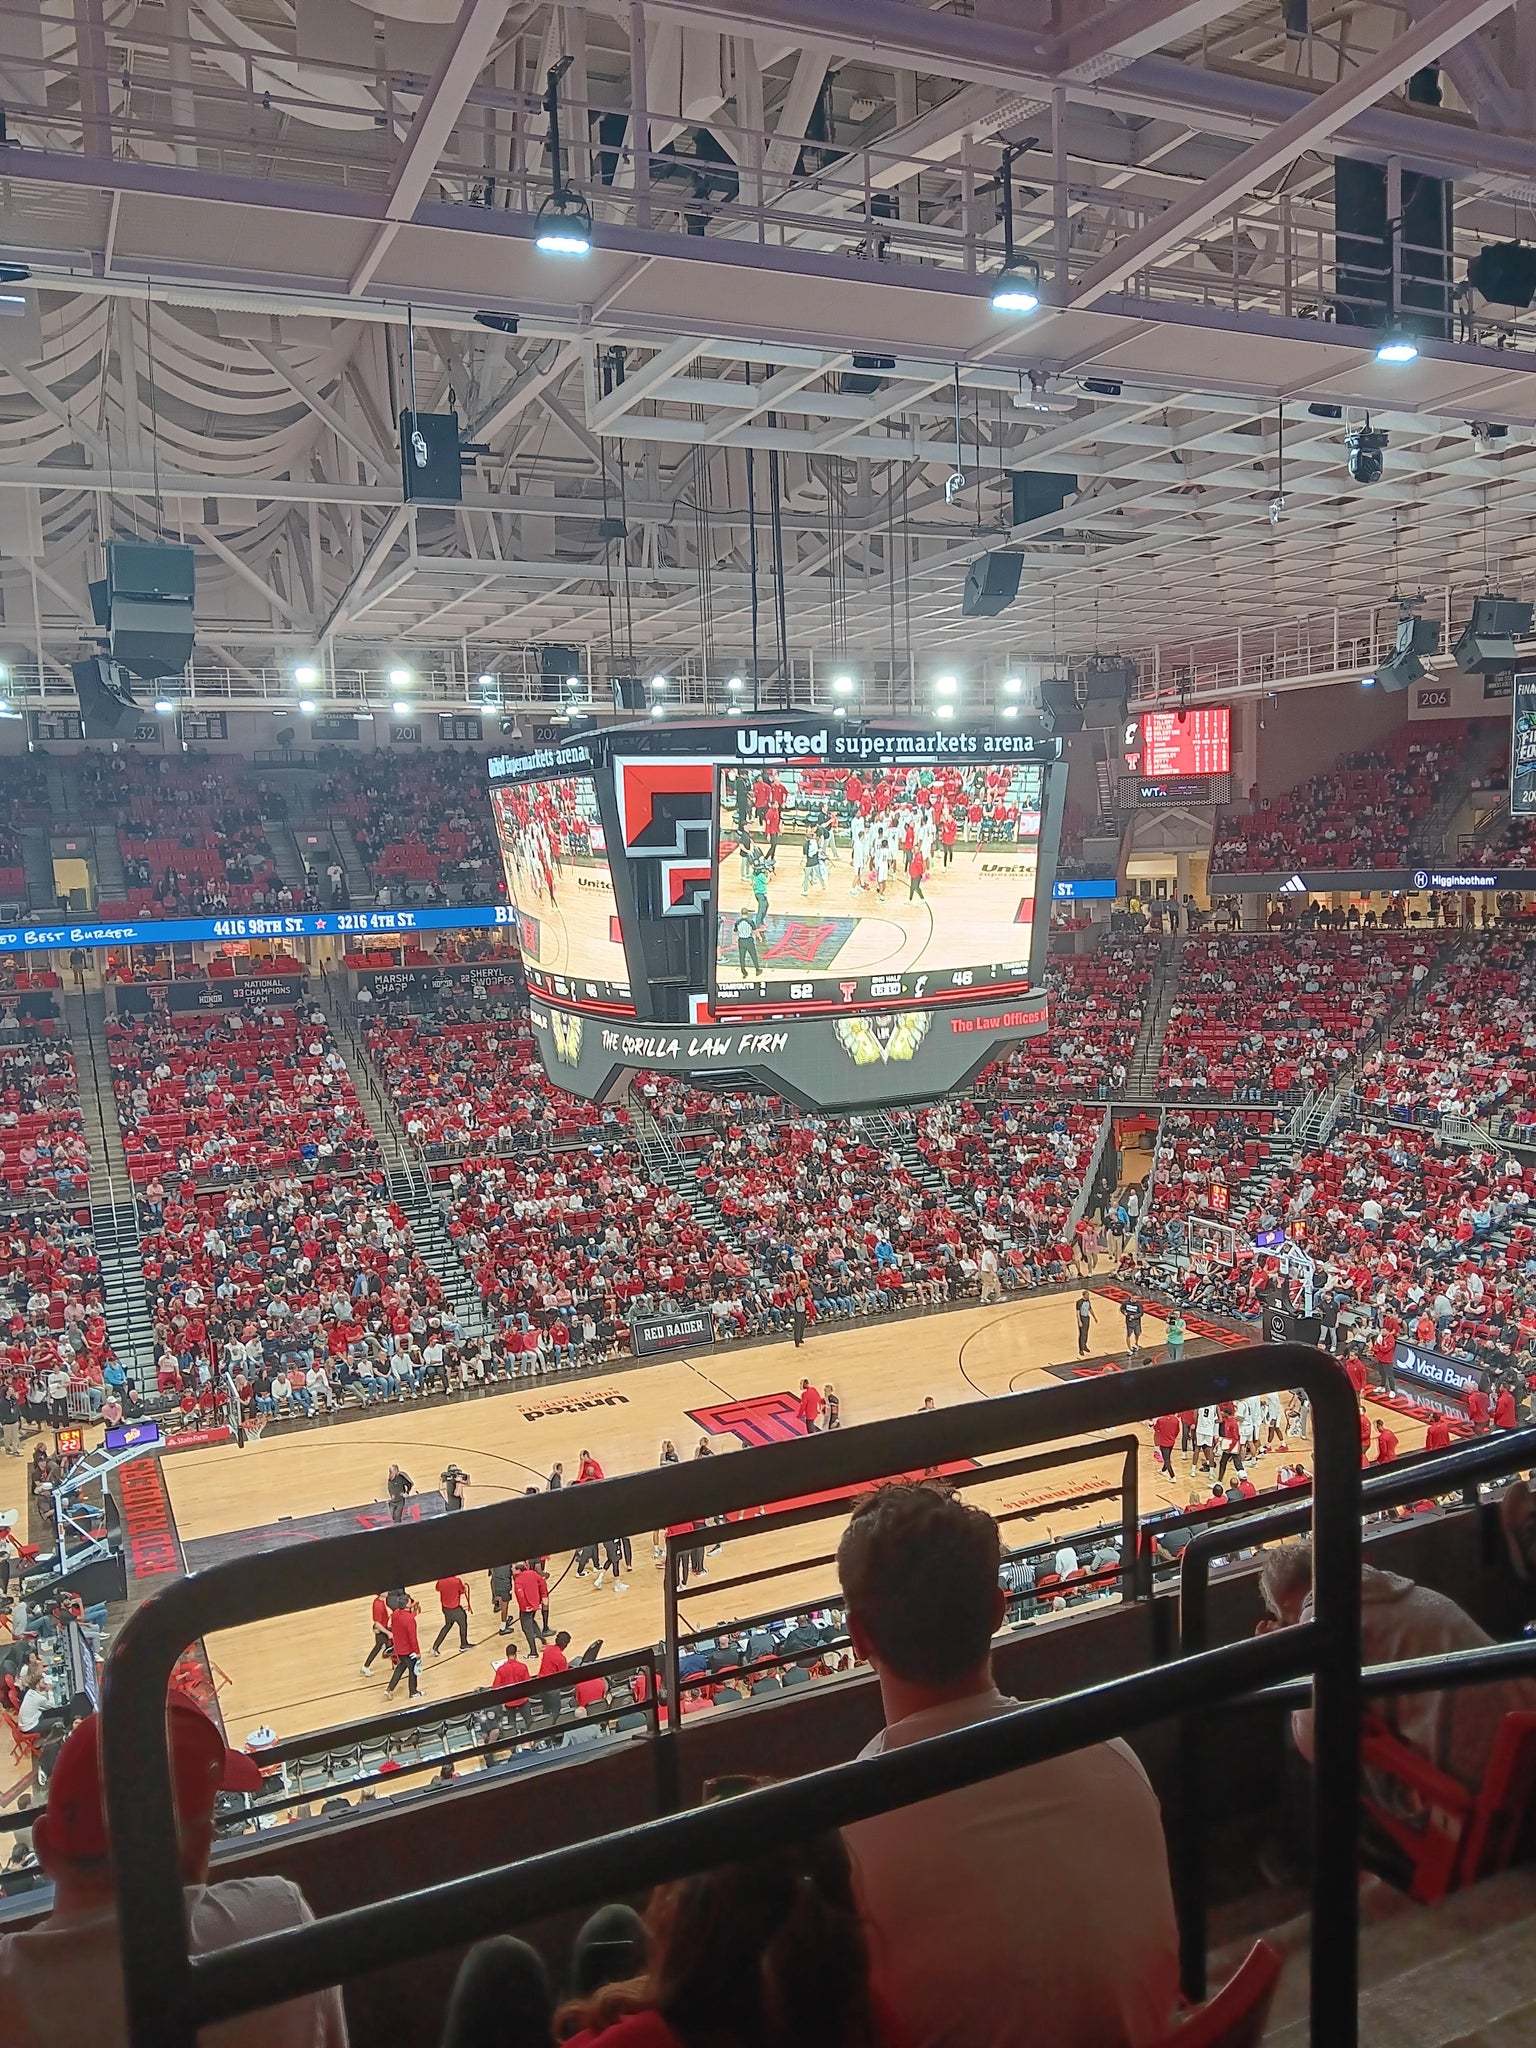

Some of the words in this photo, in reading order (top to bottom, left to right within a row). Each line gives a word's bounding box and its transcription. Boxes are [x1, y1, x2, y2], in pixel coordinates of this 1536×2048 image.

[1517, 683, 1536, 695] FINA
[1421, 692, 1447, 706] 206
[133, 727, 156, 740] 32
[396, 728, 416, 740] 201
[736, 729, 828, 755] United
[835, 731, 977, 759] supermarkets
[983, 736, 1034, 752] arena
[505, 748, 554, 777] supermarkets
[556, 746, 585, 765] arena
[1057, 882, 1075, 896] ST.
[213, 919, 246, 936] 4416
[249, 918, 282, 934] 98TH
[285, 917, 305, 933] ST.
[337, 914, 369, 930] 3216
[370, 913, 396, 928] 4TH
[397, 912, 417, 927] ST.
[374, 973, 416, 984] MARSHA
[460, 974, 470, 983] 22
[470, 968, 505, 978] SHERYL
[244, 979, 283, 988] NATIONAL
[233, 988, 245, 998] 93
[245, 986, 291, 996] CHAMPIONS
[951, 1019, 973, 1033] The
[976, 1016, 1001, 1030] Law
[1003, 1012, 1039, 1027] Offices
[601, 1029, 620, 1052] THE
[621, 1035, 682, 1060] GORILLA
[687, 1036, 732, 1059] LAW
[737, 1032, 789, 1055] FIRM
[643, 1326, 665, 1341] RED
[666, 1319, 706, 1337] RAIDER
[1416, 1357, 1444, 1382] Vista
[522, 1395, 630, 1422] United
[1203, 1408, 1209, 1418] 9
[62, 1439, 77, 1451] 22
[118, 1457, 169, 1536] RAIDERS
[130, 1532, 178, 1579] RED
